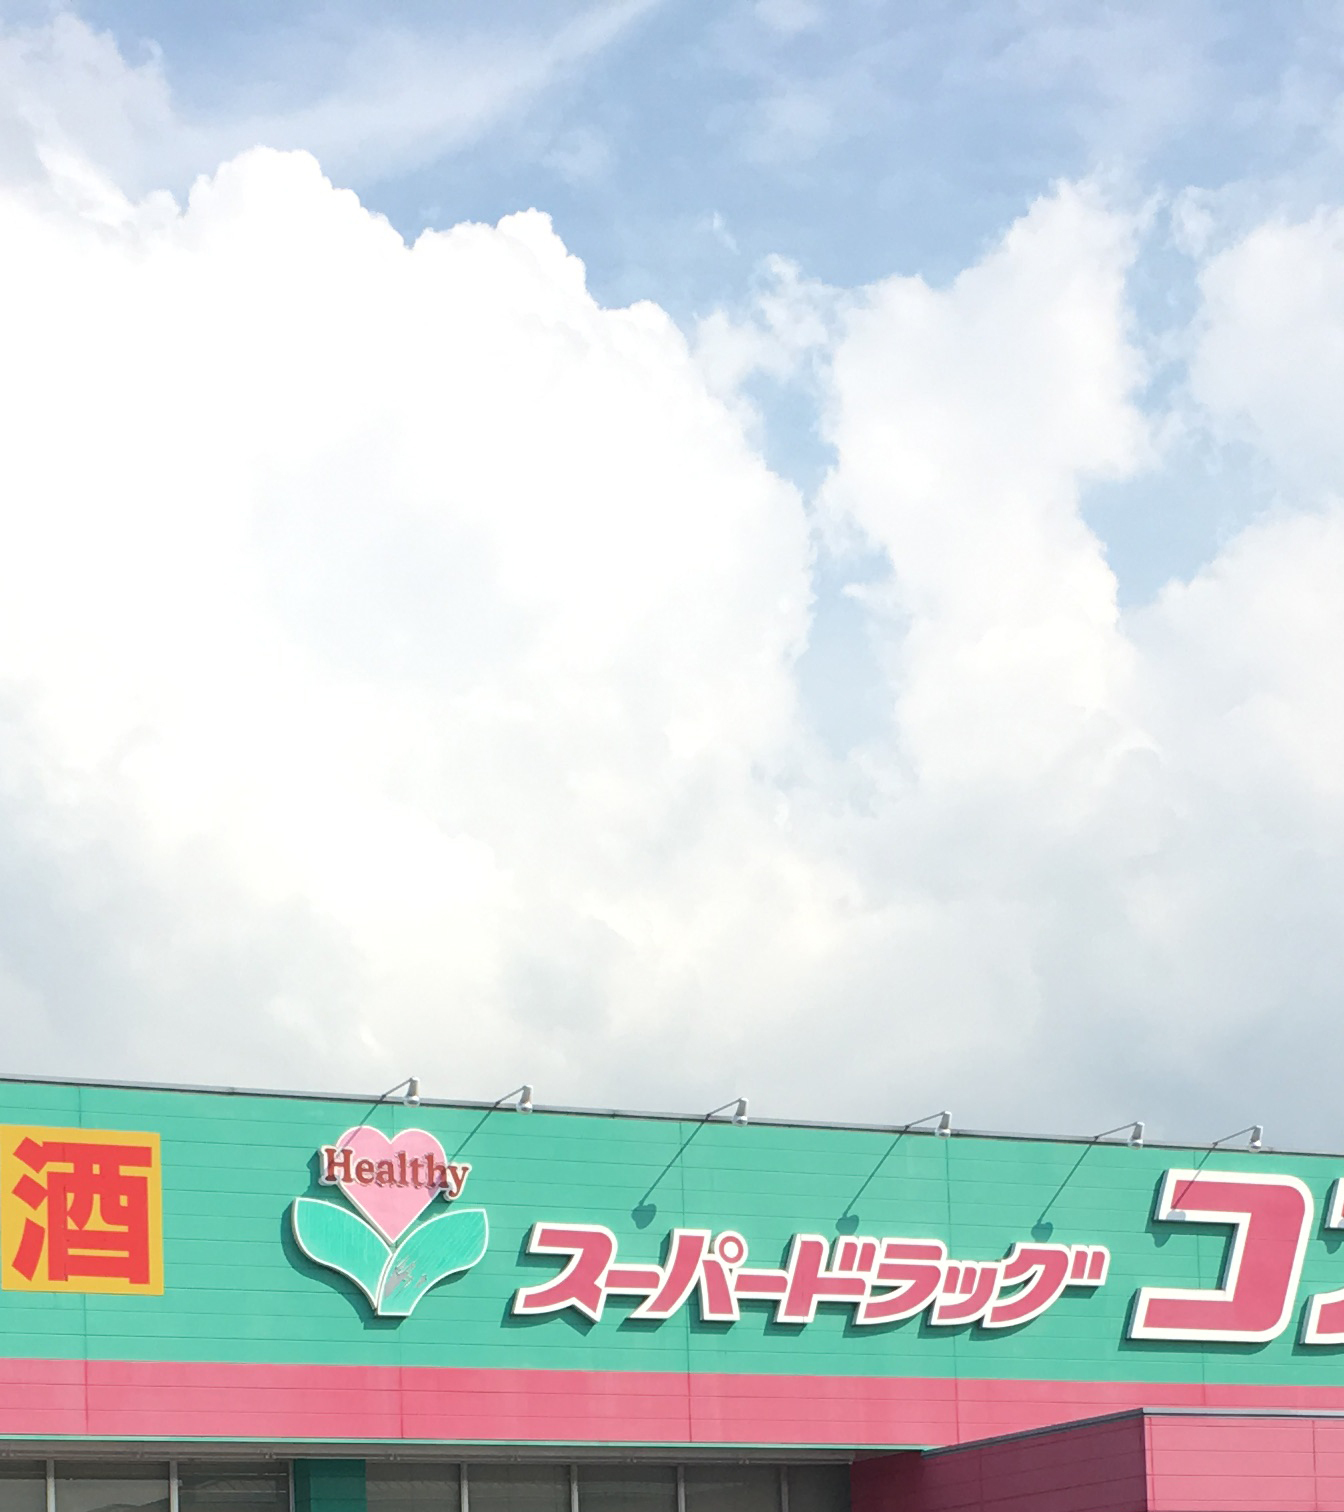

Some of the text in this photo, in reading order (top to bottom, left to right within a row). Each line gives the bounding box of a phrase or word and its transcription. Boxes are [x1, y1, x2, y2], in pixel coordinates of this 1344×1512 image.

[10, 1136, 153, 1285] 酒
[320, 1146, 470, 1201] Healthy
[514, 1222, 1110, 1329] スーパードラッグ
